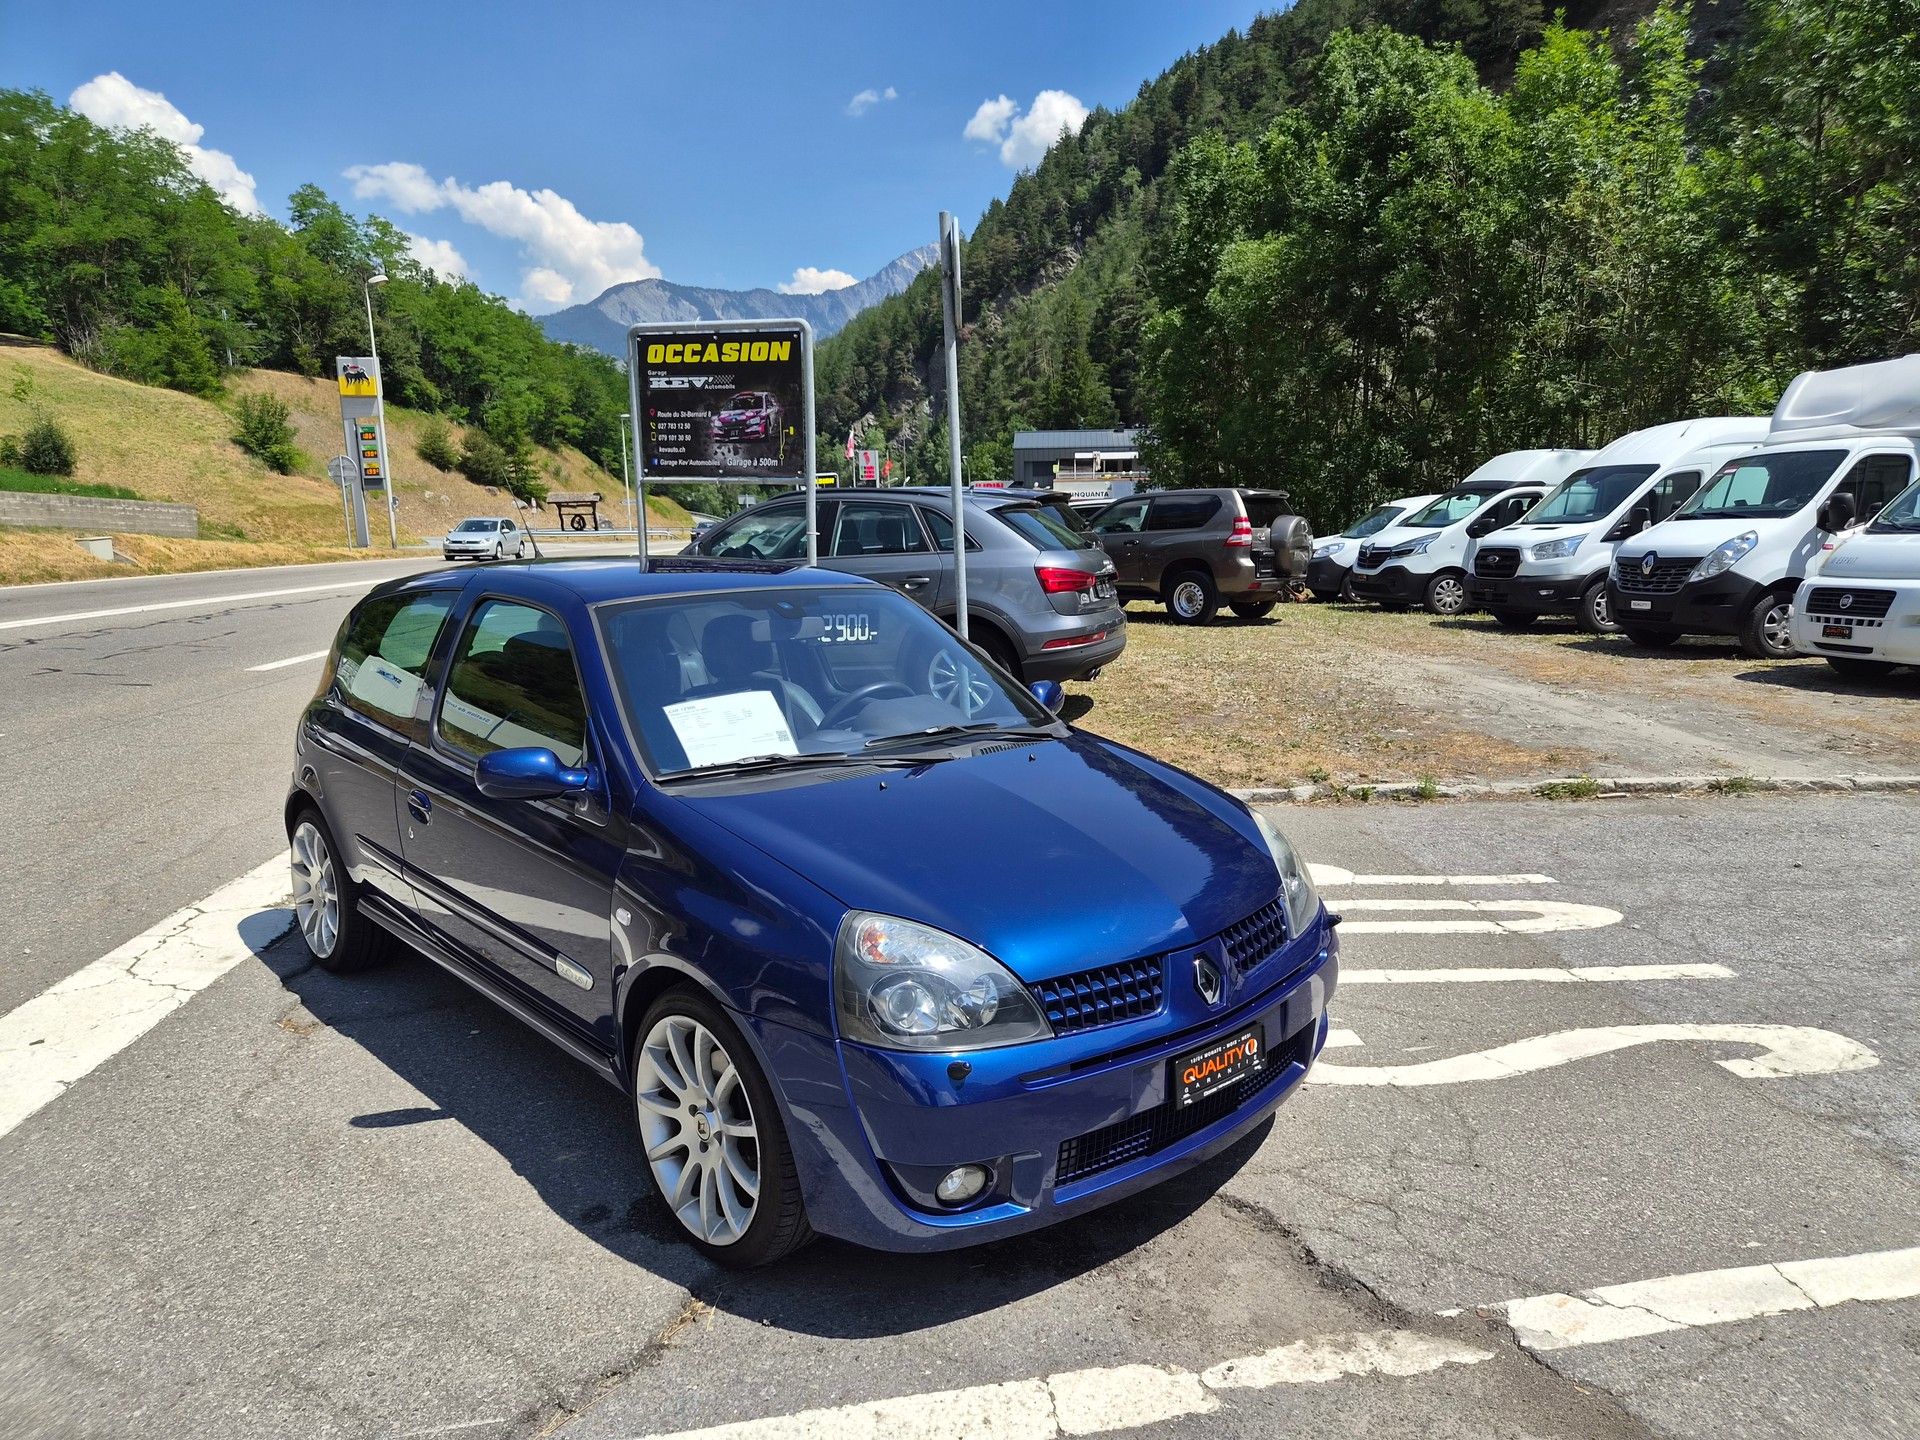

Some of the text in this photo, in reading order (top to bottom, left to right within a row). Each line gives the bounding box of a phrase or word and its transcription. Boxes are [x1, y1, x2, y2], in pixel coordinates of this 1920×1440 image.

[647, 341, 791, 363] OCCASION
[660, 459, 677, 467] Garage
[727, 458, 778, 467] Garage à 500m
[817, 614, 878, 642] 2'900.-
